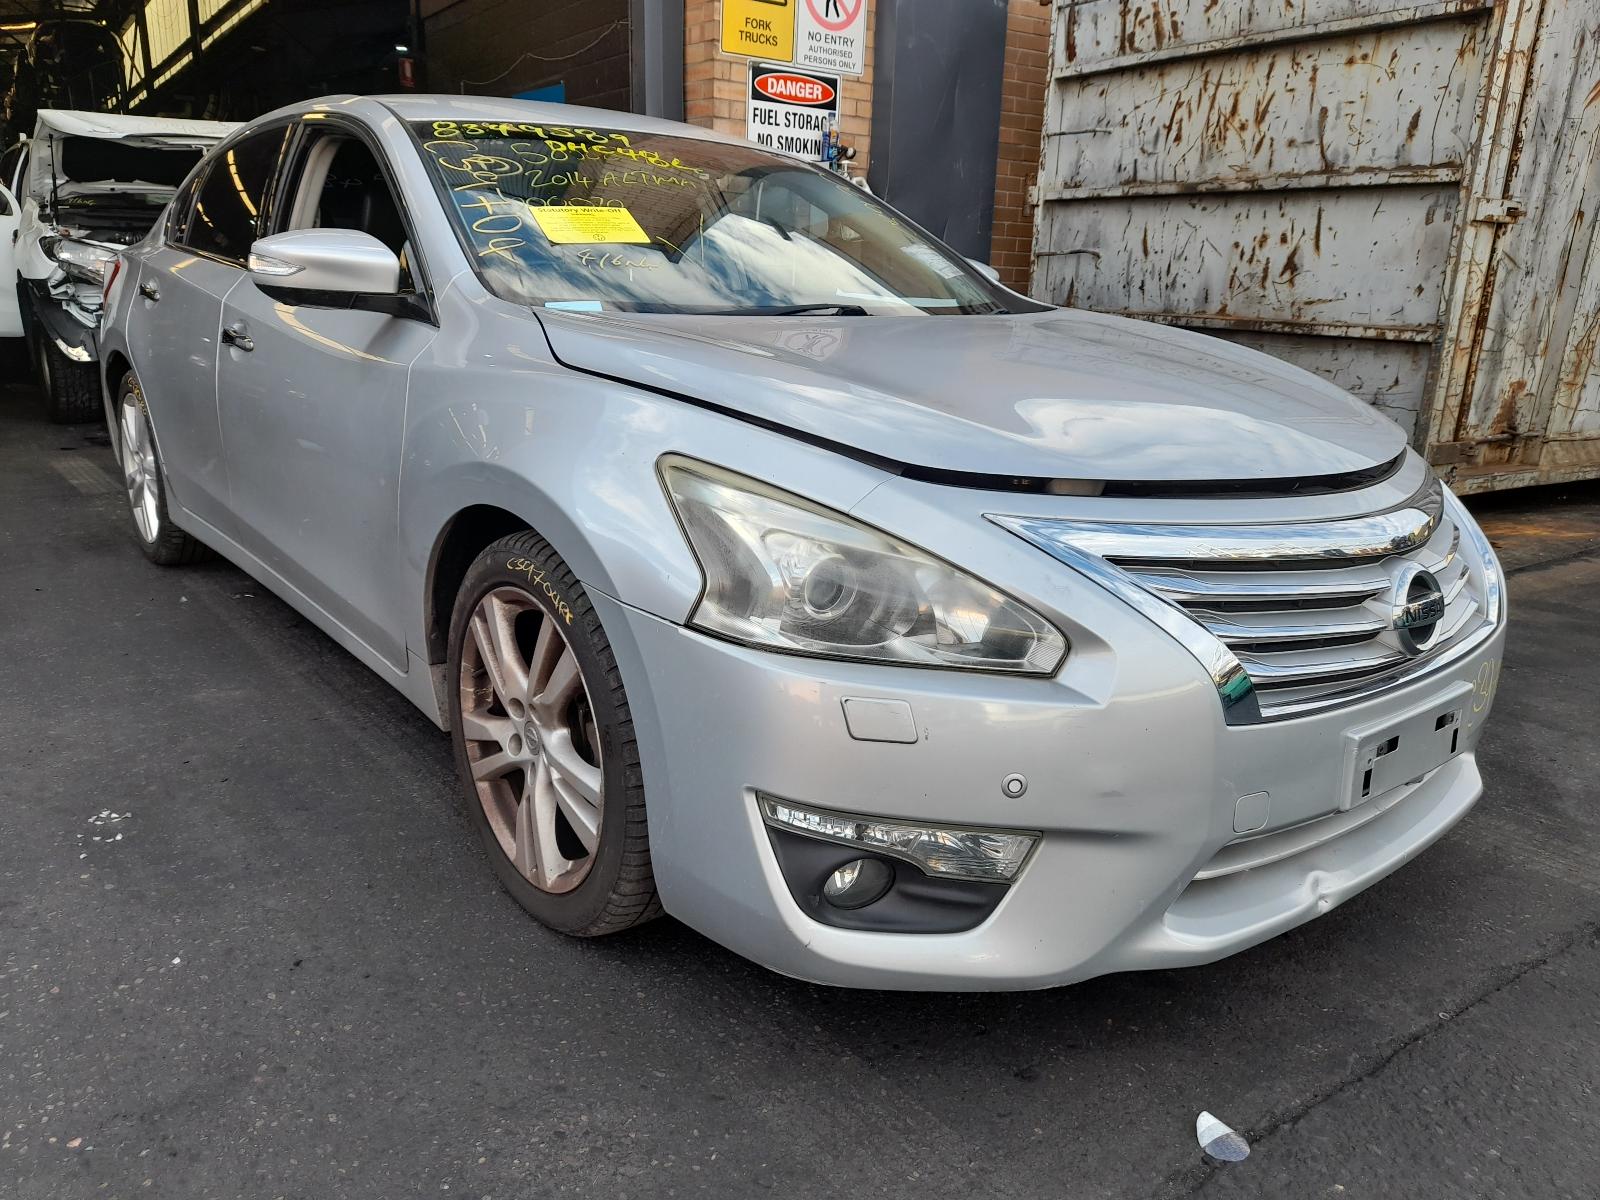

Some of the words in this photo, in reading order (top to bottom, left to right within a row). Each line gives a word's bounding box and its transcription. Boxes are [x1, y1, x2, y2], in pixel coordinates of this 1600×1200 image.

[745, 17, 772, 31] FORK
[739, 30, 778, 47] TRUCKS
[808, 31, 822, 42] NO
[824, 33, 855, 48] ENTRY
[808, 45, 853, 59] AUTHORISED
[804, 54, 837, 67] PERSONS
[838, 59, 857, 70] ONLY
[767, 77, 822, 100] DANGER
[752, 107, 780, 127] FUEL
[784, 111, 827, 132] STORA
[757, 133, 773, 148] NO
[777, 134, 821, 156] SMOKIN
[525, 169, 593, 189] 2014
